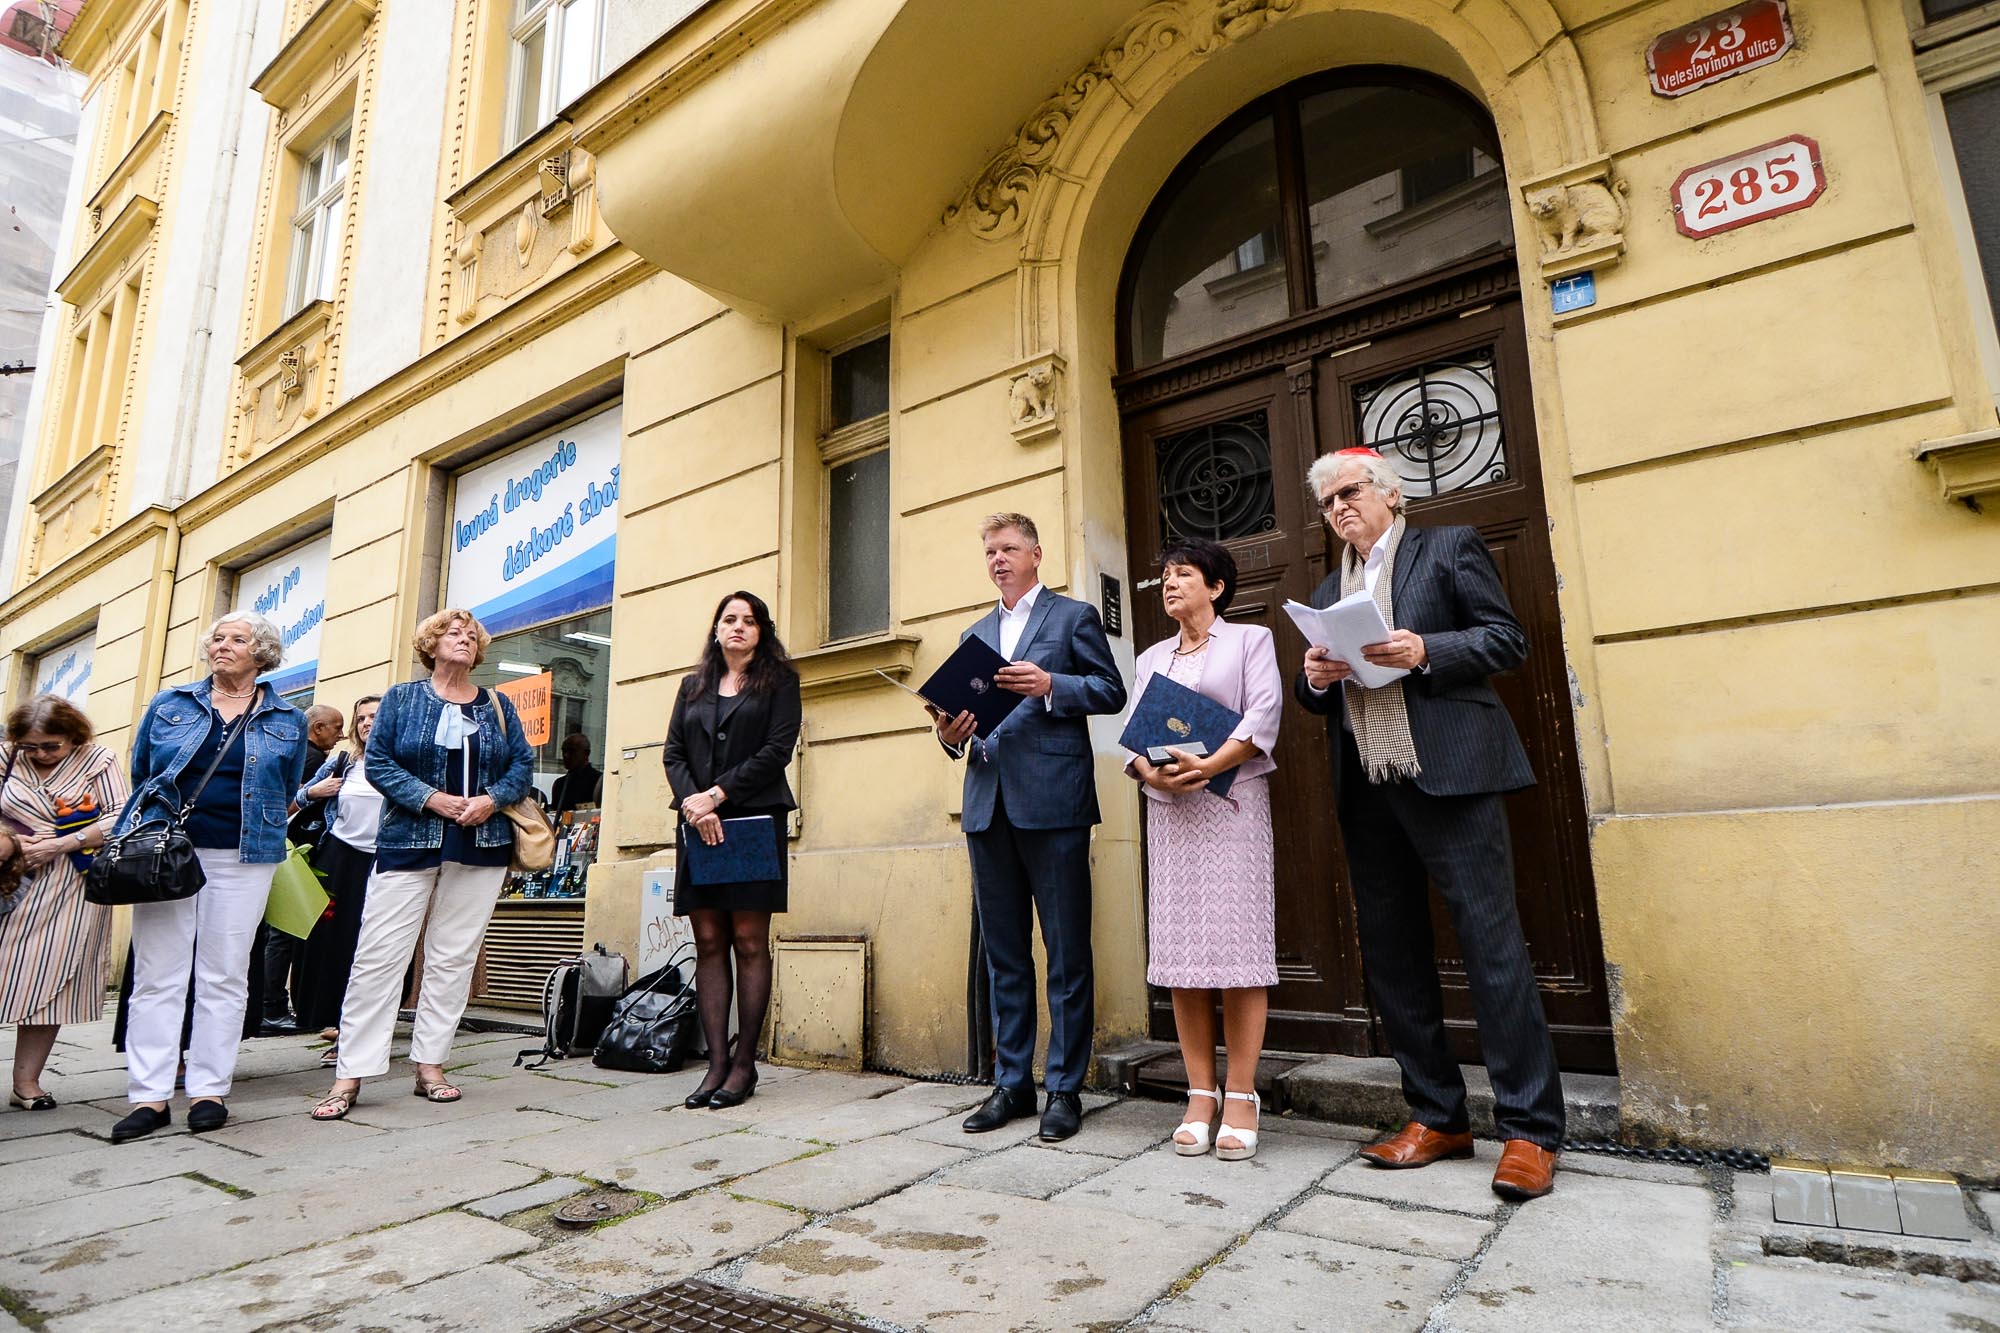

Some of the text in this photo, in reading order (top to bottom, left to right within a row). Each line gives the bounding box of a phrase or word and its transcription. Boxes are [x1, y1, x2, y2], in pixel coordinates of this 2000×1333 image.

[1661, 38, 1777, 90] Veleslavínova ulice
[1685, 14, 1746, 64] 23
[1694, 153, 1800, 220] 285
[456, 440, 577, 552] levná drogerie
[503, 502, 574, 581] dárkové
[283, 566, 301, 603] pro
